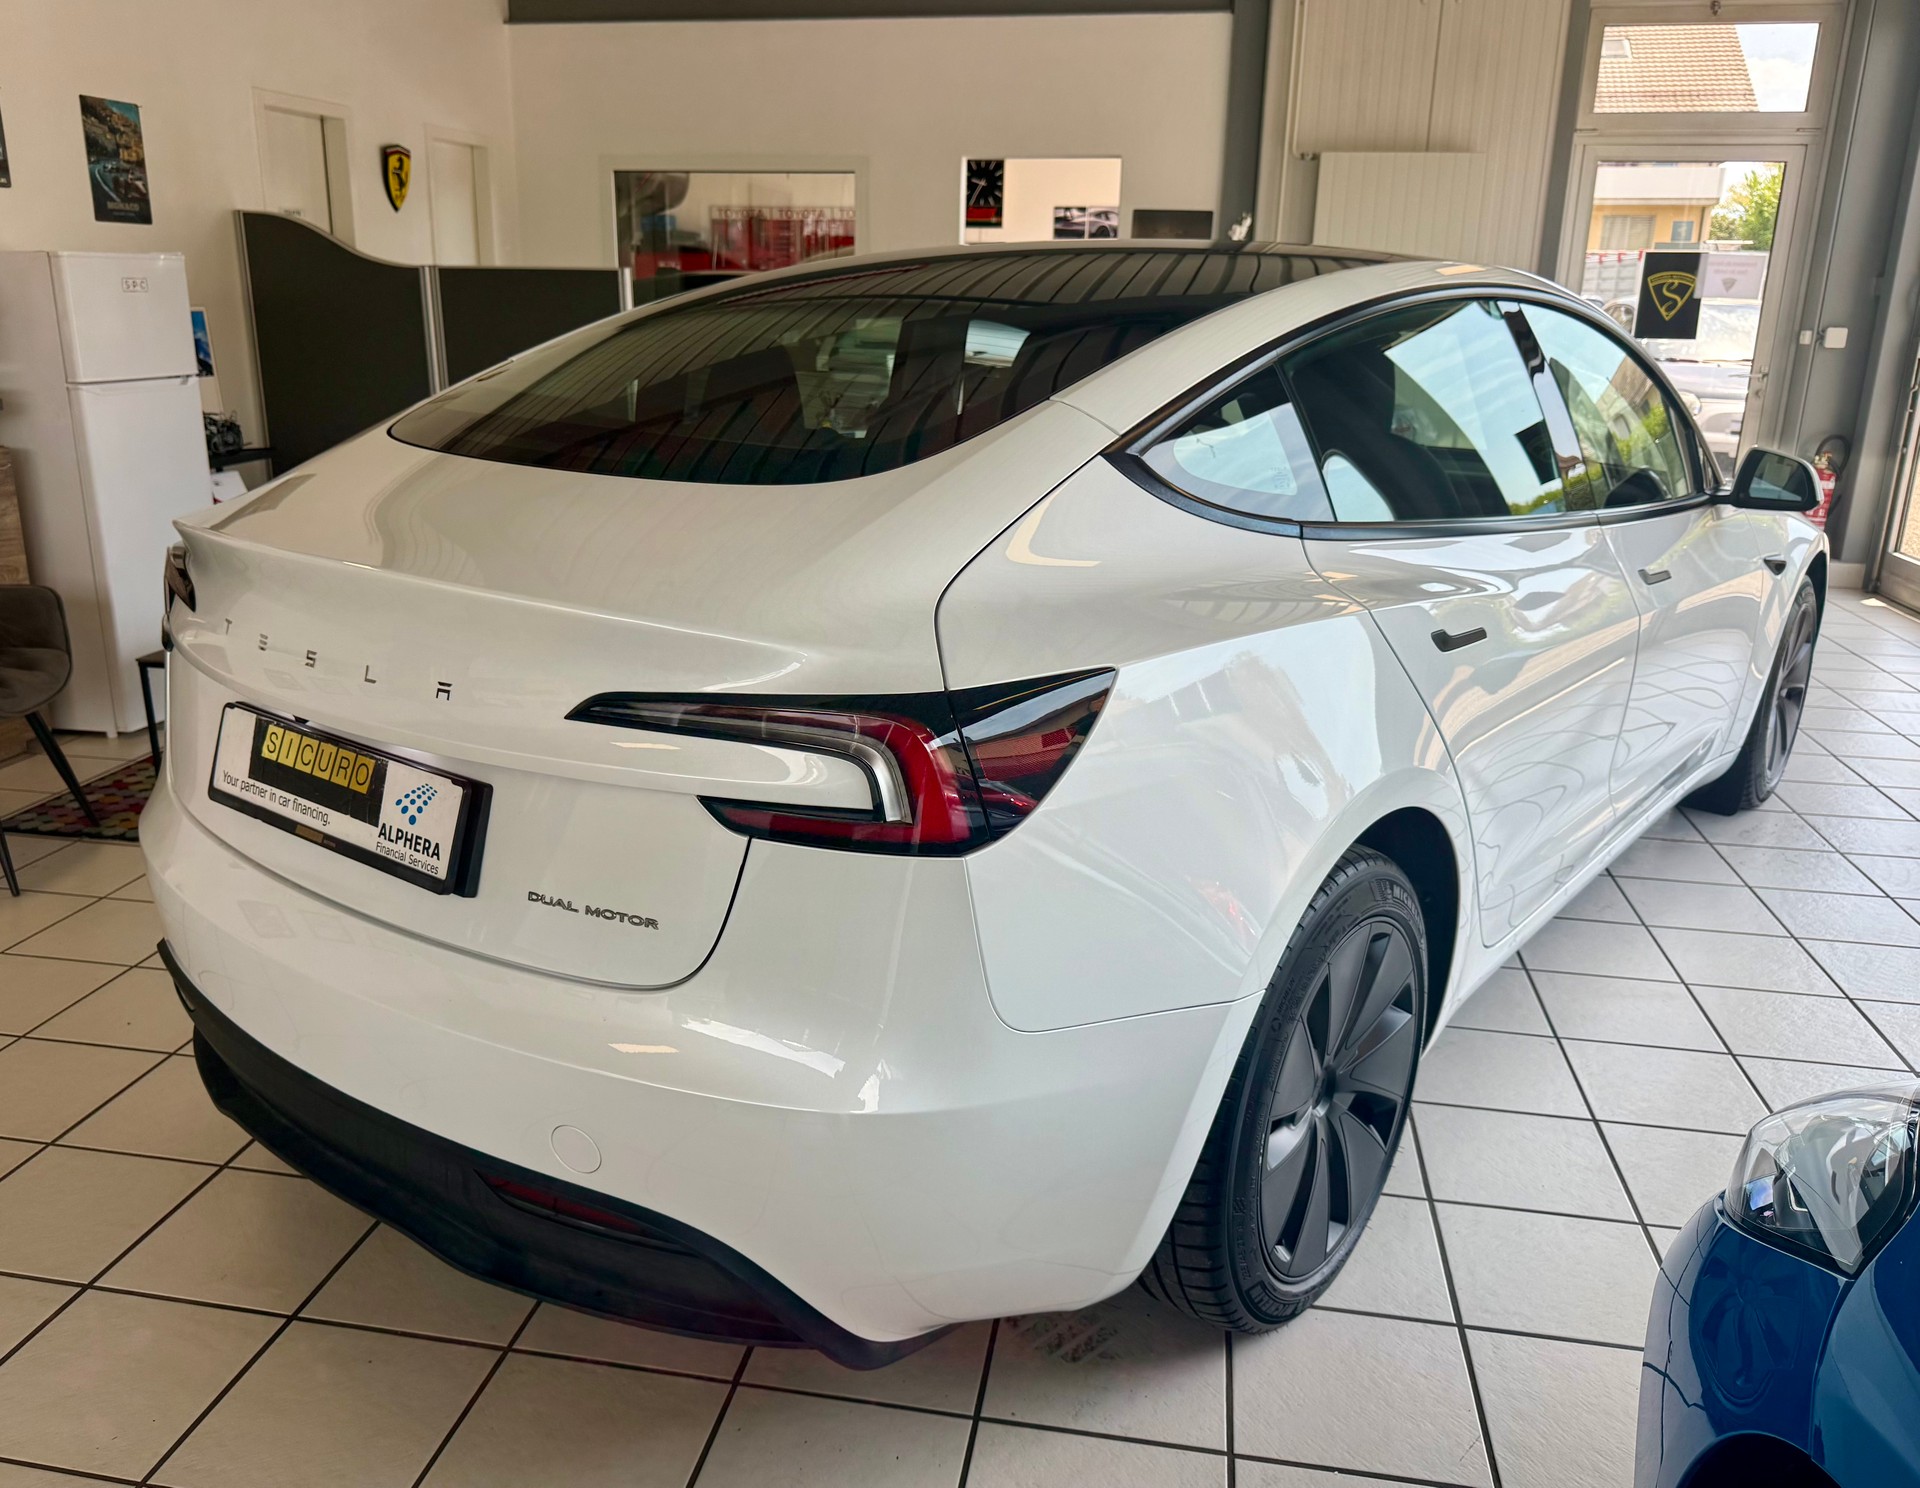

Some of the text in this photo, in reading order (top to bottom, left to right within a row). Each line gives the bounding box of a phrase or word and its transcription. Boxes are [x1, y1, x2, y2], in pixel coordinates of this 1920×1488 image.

[225, 618, 453, 701] TESLA
[266, 731, 370, 786] SICURO
[222, 769, 331, 826] Your partner in car financing.
[375, 841, 440, 875] Financial Services
[378, 822, 440, 861] ALPHERA
[528, 891, 659, 930] DUAL MOTOR
